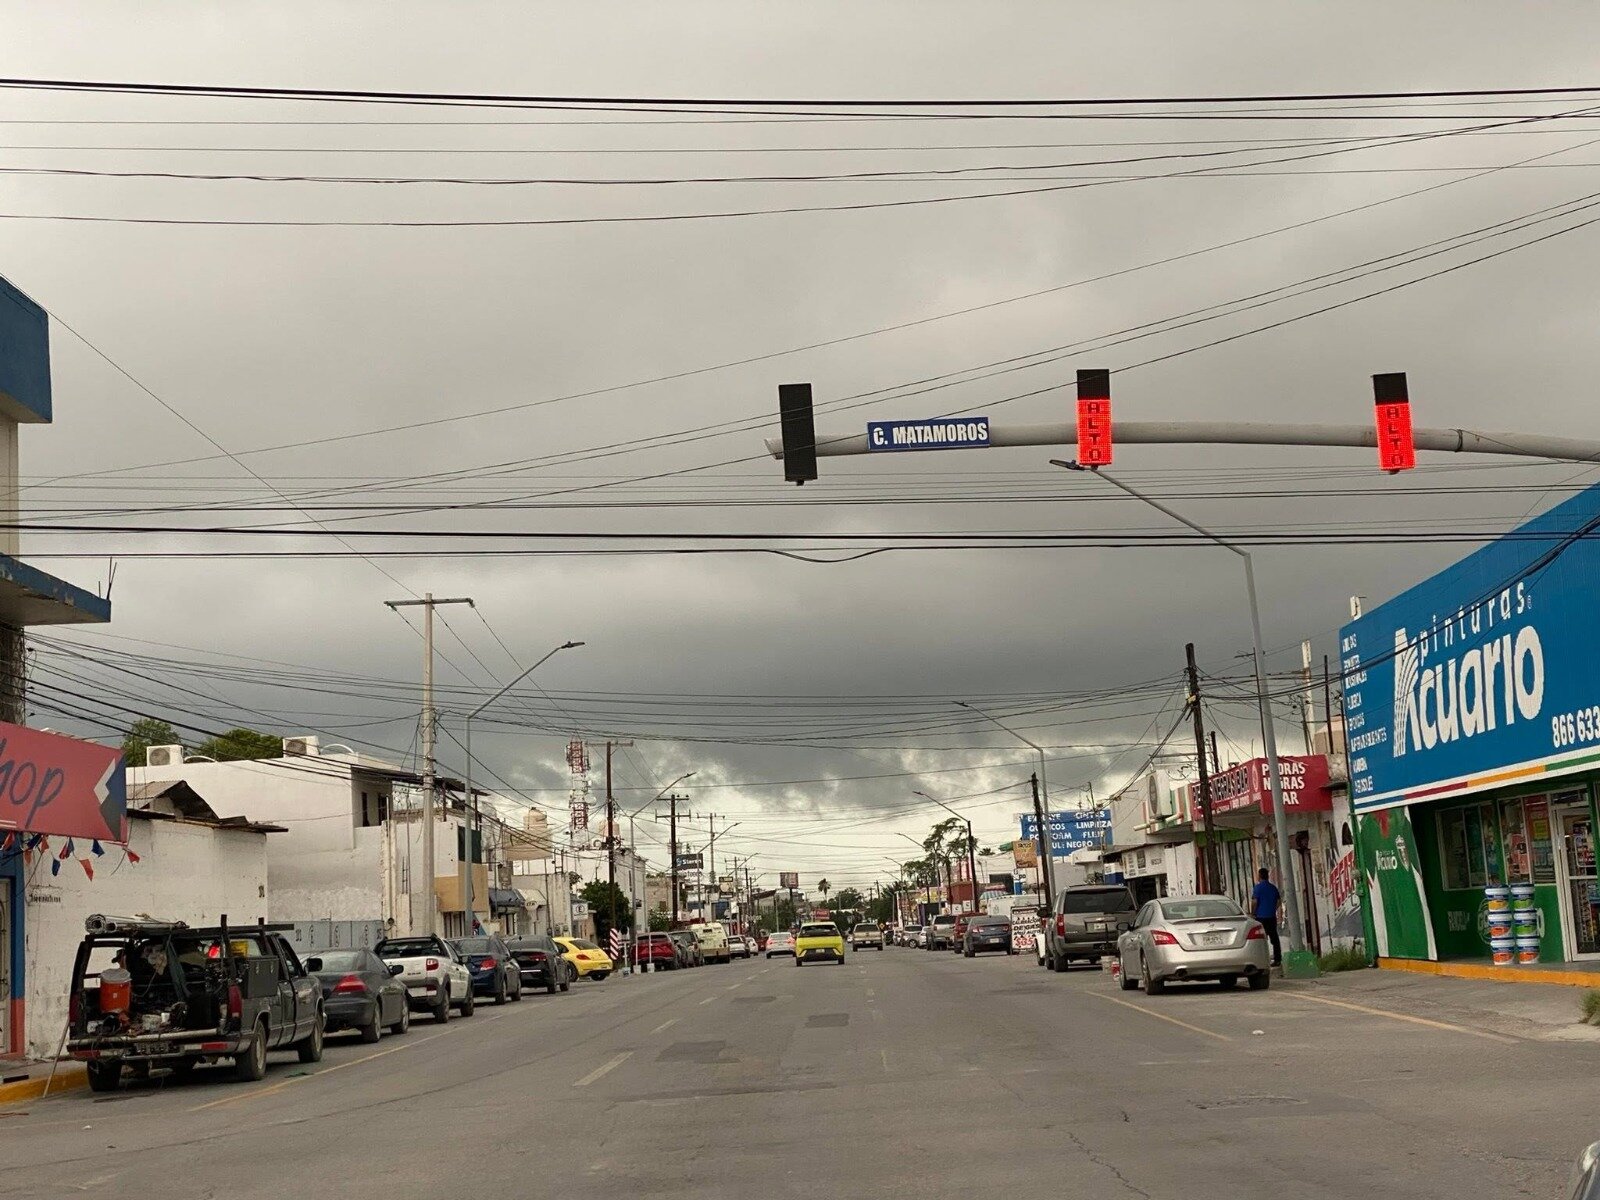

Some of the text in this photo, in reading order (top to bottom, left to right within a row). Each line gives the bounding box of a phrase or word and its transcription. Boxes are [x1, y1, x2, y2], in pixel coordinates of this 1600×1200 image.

[873, 422, 988, 446] C. MATAMOROS
[1419, 582, 1525, 667] pinturas
[1393, 625, 1545, 758] Acuario
[1552, 705, 1600, 748] 866 633
[1262, 762, 1306, 776] PDRAS
[1066, 840, 1093, 848] NEGRO
